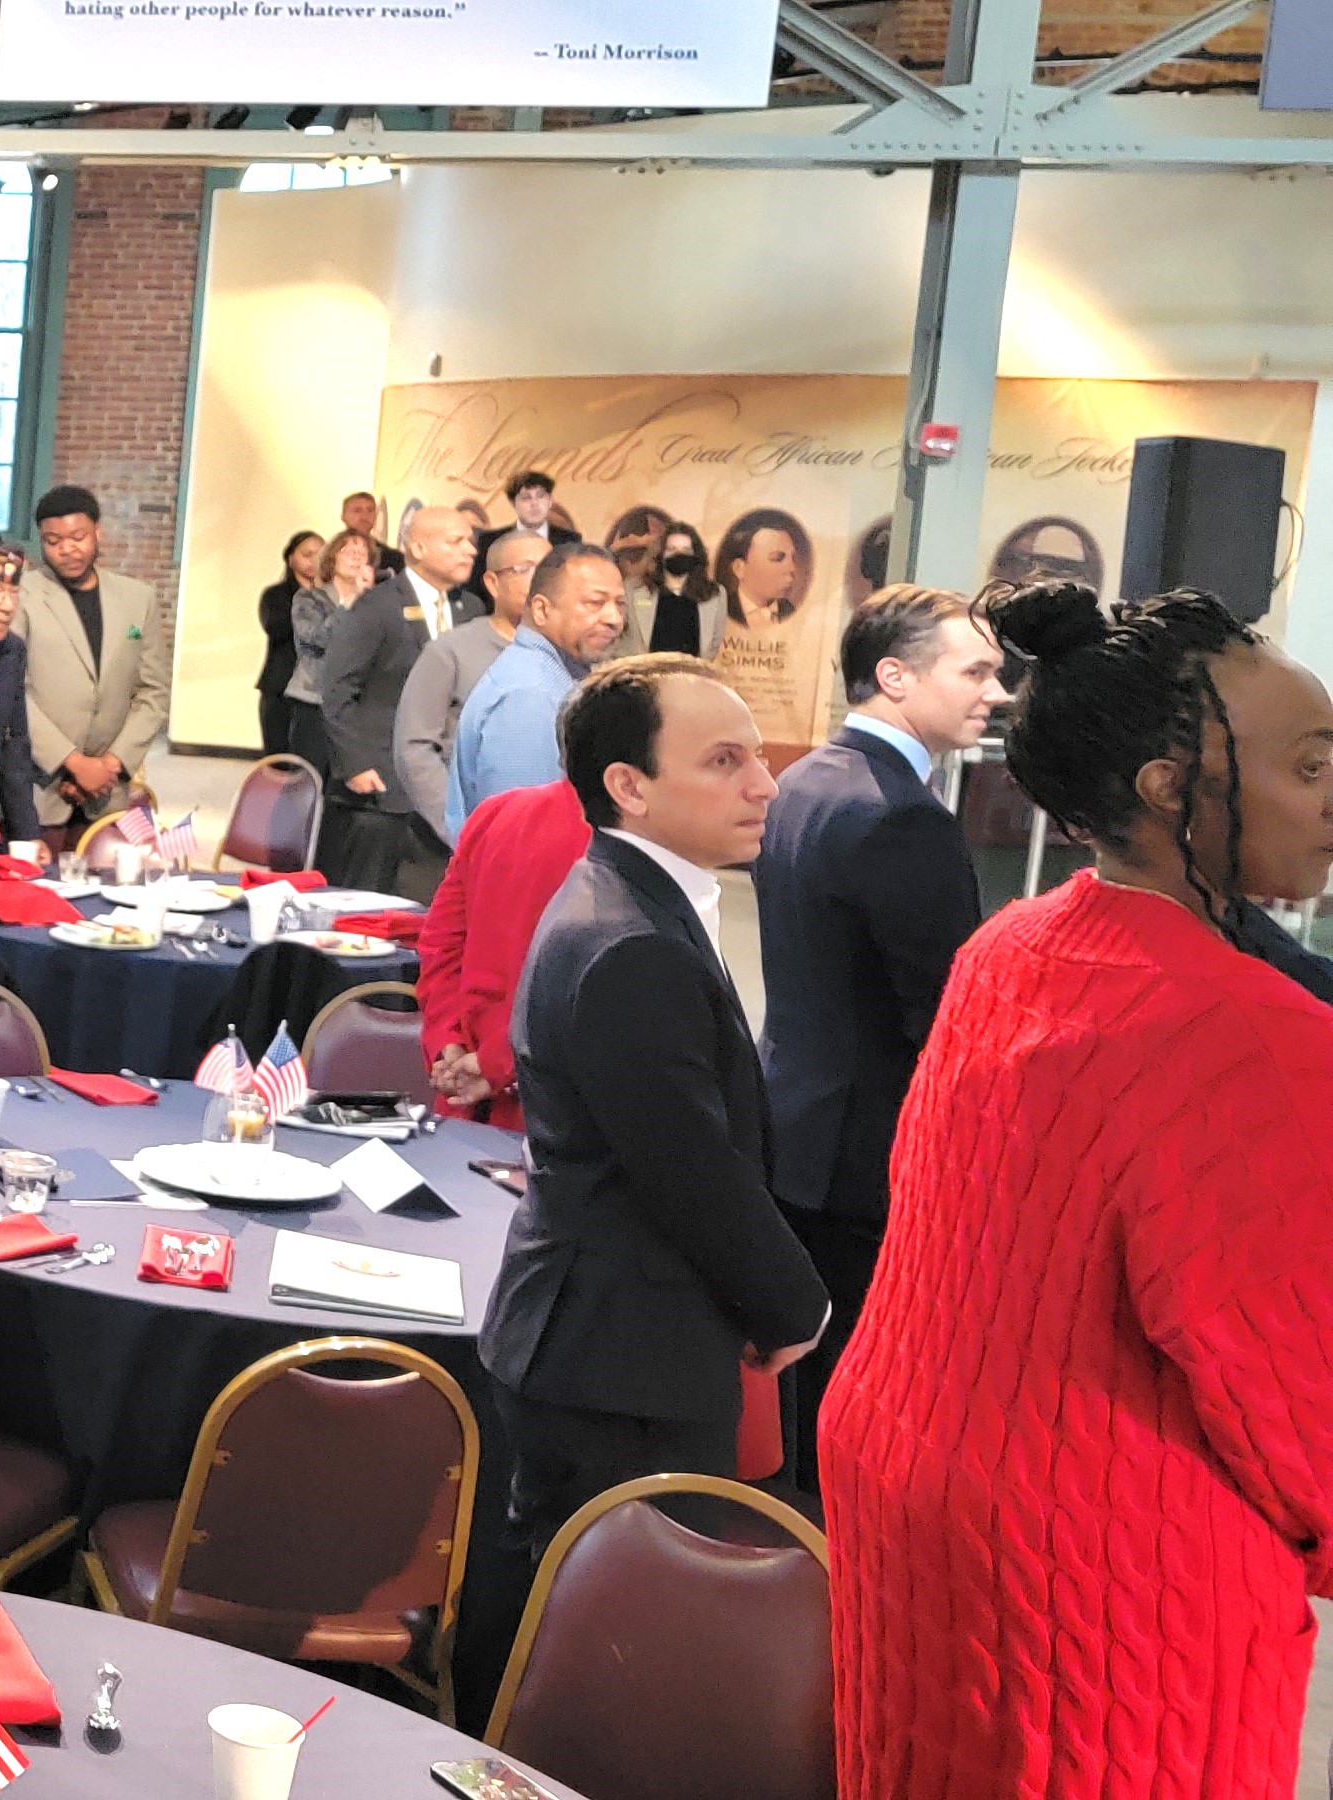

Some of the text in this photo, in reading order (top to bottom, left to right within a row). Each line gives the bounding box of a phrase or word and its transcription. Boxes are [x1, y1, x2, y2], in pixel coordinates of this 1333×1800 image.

[64, 1, 124, 19] hating
[129, 1, 180, 16] other
[185, 2, 249, 20] people
[254, 1, 282, 17] for
[288, 2, 375, 18] whatever
[554, 43, 598, 59] Toni
[603, 44, 699, 60] Morrison
[653, 433, 742, 473] Great
[742, 431, 864, 477] African
[723, 636, 788, 655] WILLIE
[721, 650, 785, 671] SIMMS
